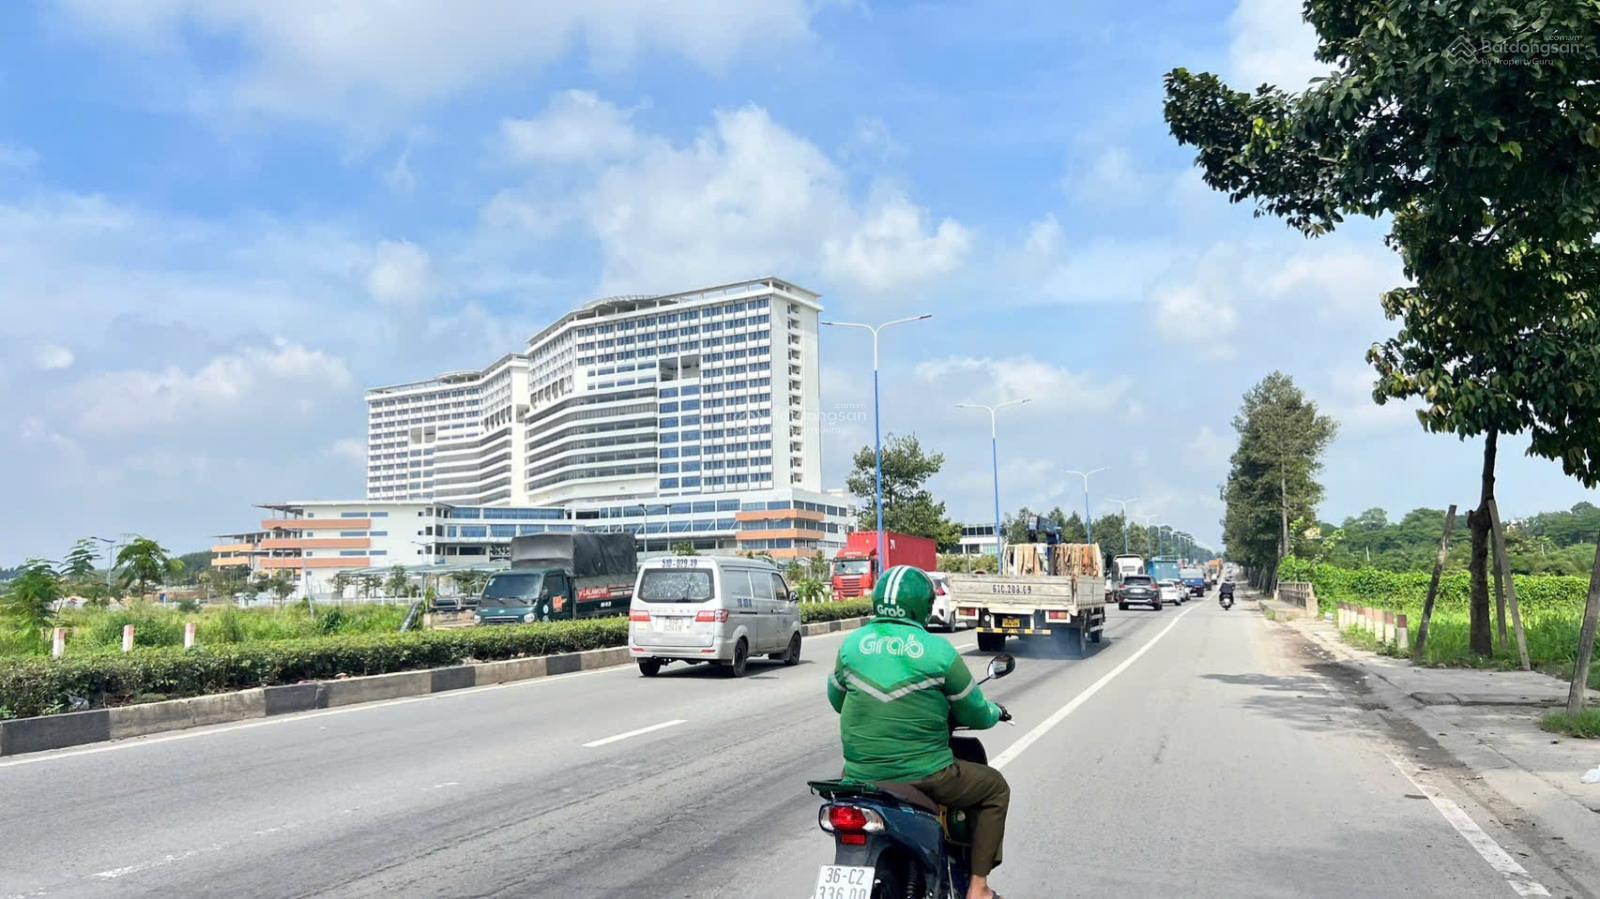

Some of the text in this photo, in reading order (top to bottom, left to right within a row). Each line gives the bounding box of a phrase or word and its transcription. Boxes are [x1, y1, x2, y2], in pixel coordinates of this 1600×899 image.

[877, 604, 905, 617] Grab
[859, 633, 924, 659] Grab
[825, 867, 865, 885] 36-C2
